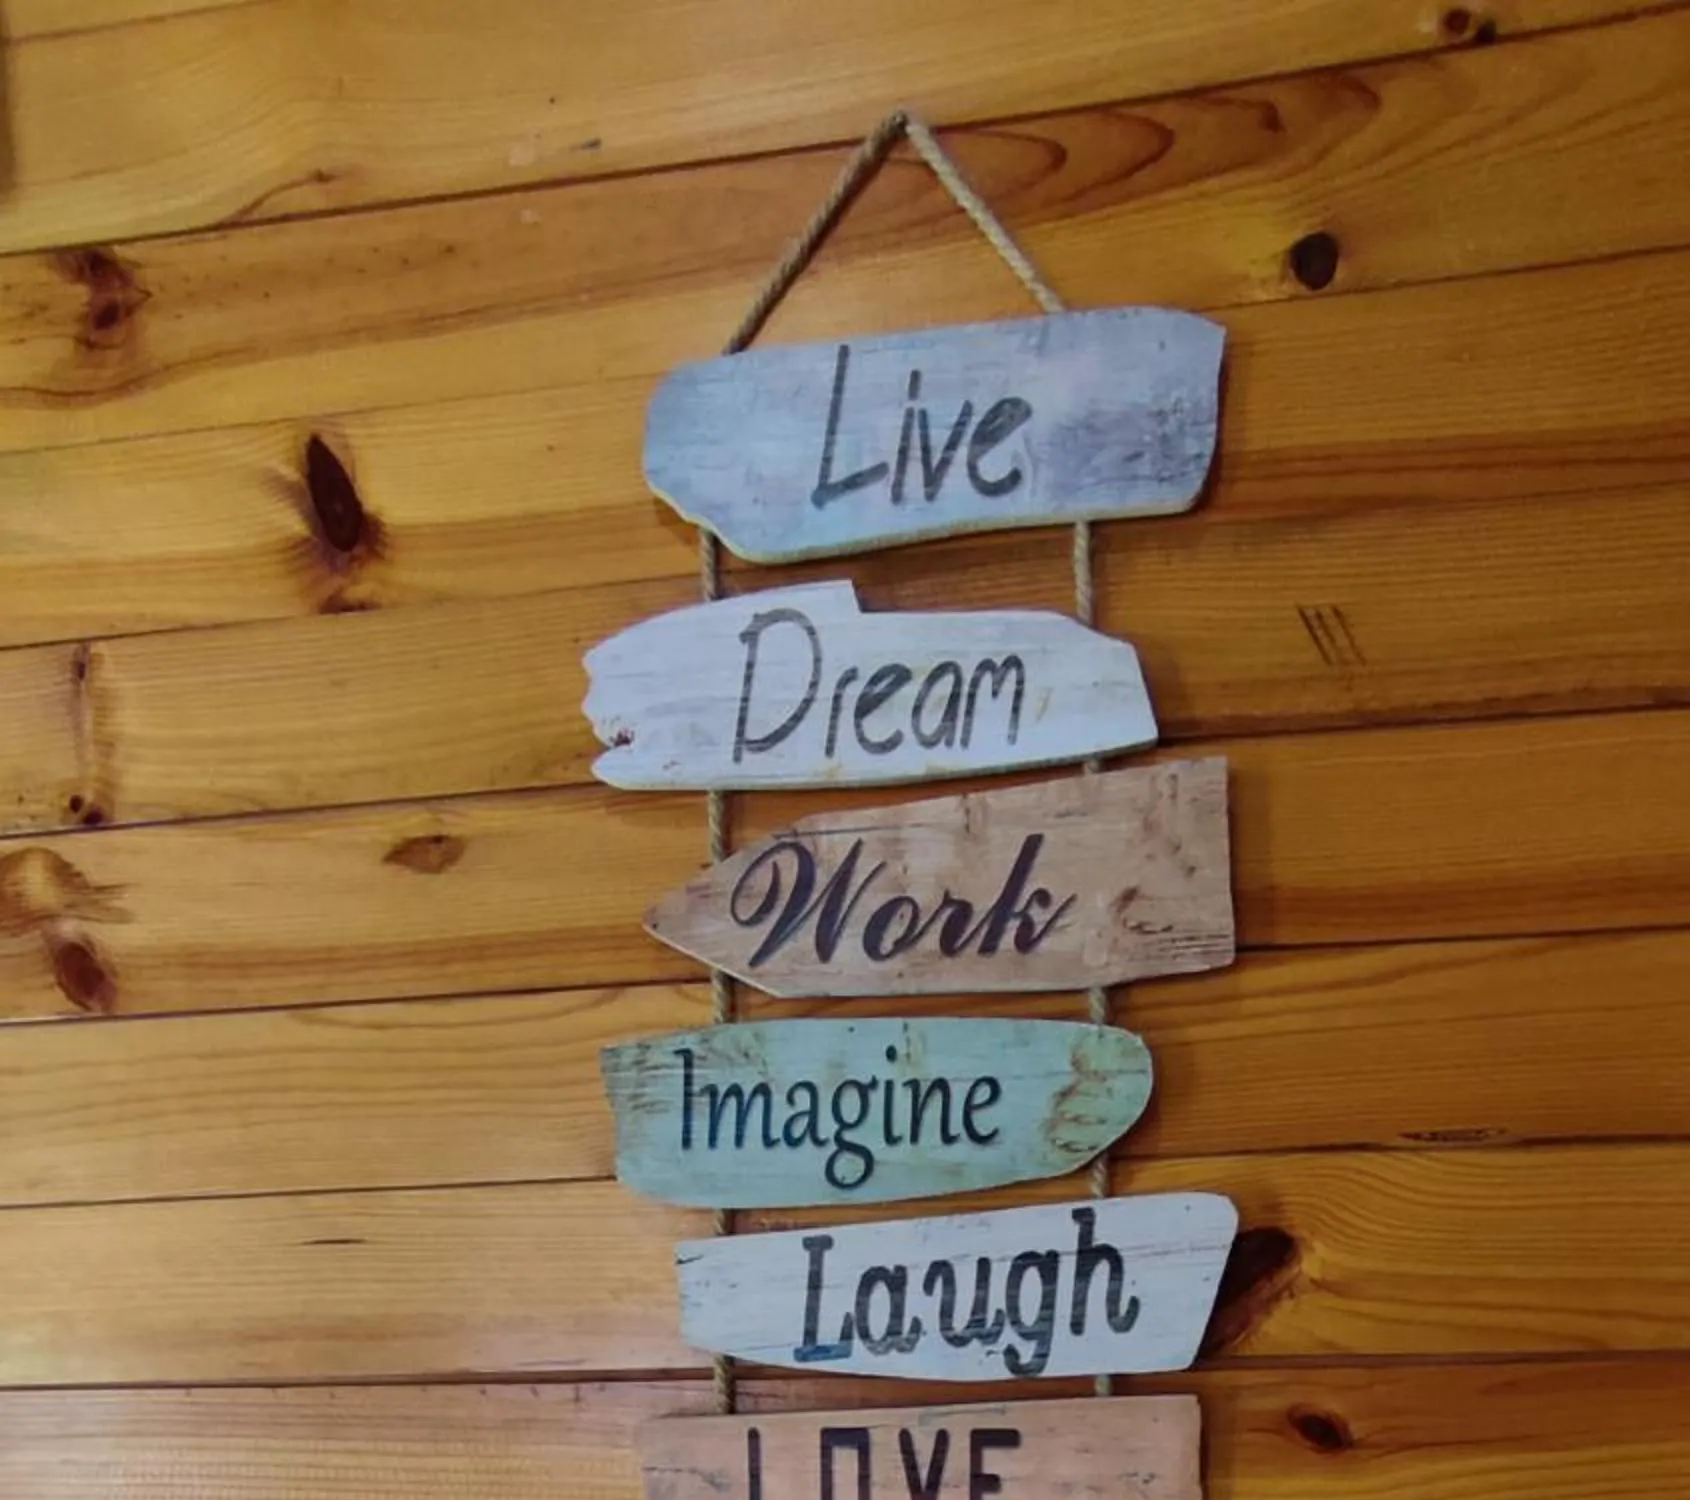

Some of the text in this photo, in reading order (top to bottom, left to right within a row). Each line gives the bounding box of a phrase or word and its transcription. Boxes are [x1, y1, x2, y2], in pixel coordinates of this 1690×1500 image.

[810, 343, 1032, 509] Live
[732, 607, 1026, 763] Dream
[729, 832, 1076, 968] Work
[674, 1046, 1001, 1190] Imagine
[793, 1206, 1140, 1378] Laugh
